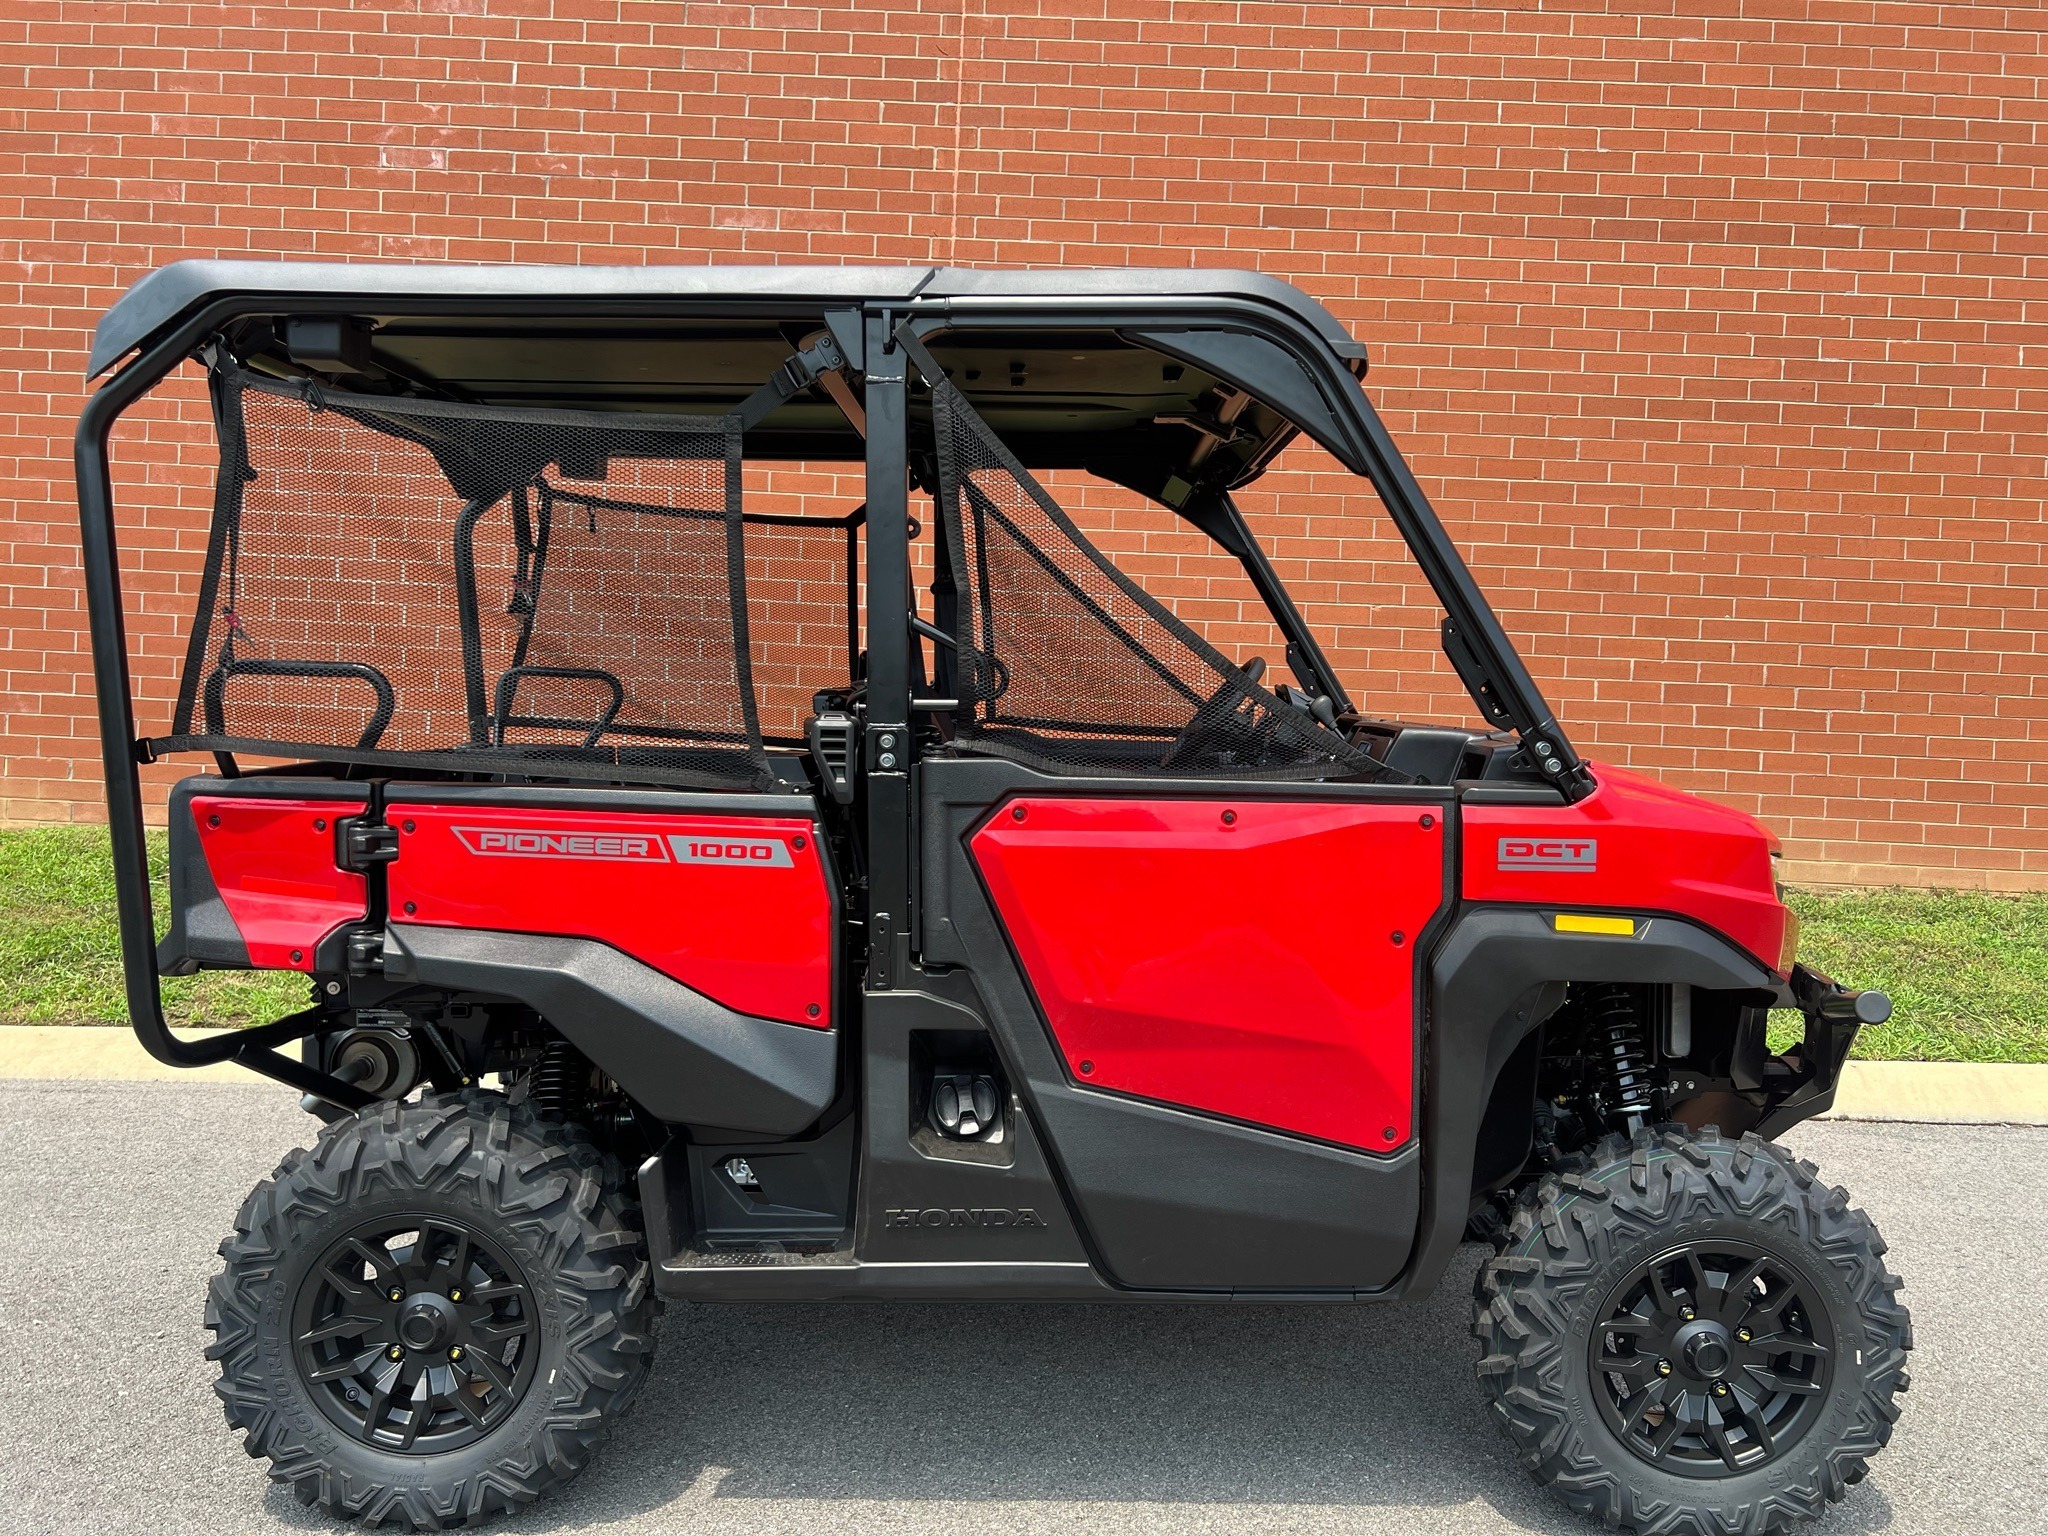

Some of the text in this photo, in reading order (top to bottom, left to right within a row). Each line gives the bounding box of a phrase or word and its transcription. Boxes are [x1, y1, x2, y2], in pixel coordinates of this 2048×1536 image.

[480, 833, 773, 860] PIONEER 1000
[1505, 842, 1590, 858] DCT
[885, 1208, 1048, 1228] HONDA
[263, 1278, 289, 1325] 2.0
[493, 1223, 561, 1339] MAXXIS
[1570, 1219, 1718, 1337] BIGHORN 2.0
[262, 1336, 338, 1460] BIGHORN
[1569, 1393, 1589, 1427] RADIAL
[1764, 1387, 1855, 1492] MAXXIS
